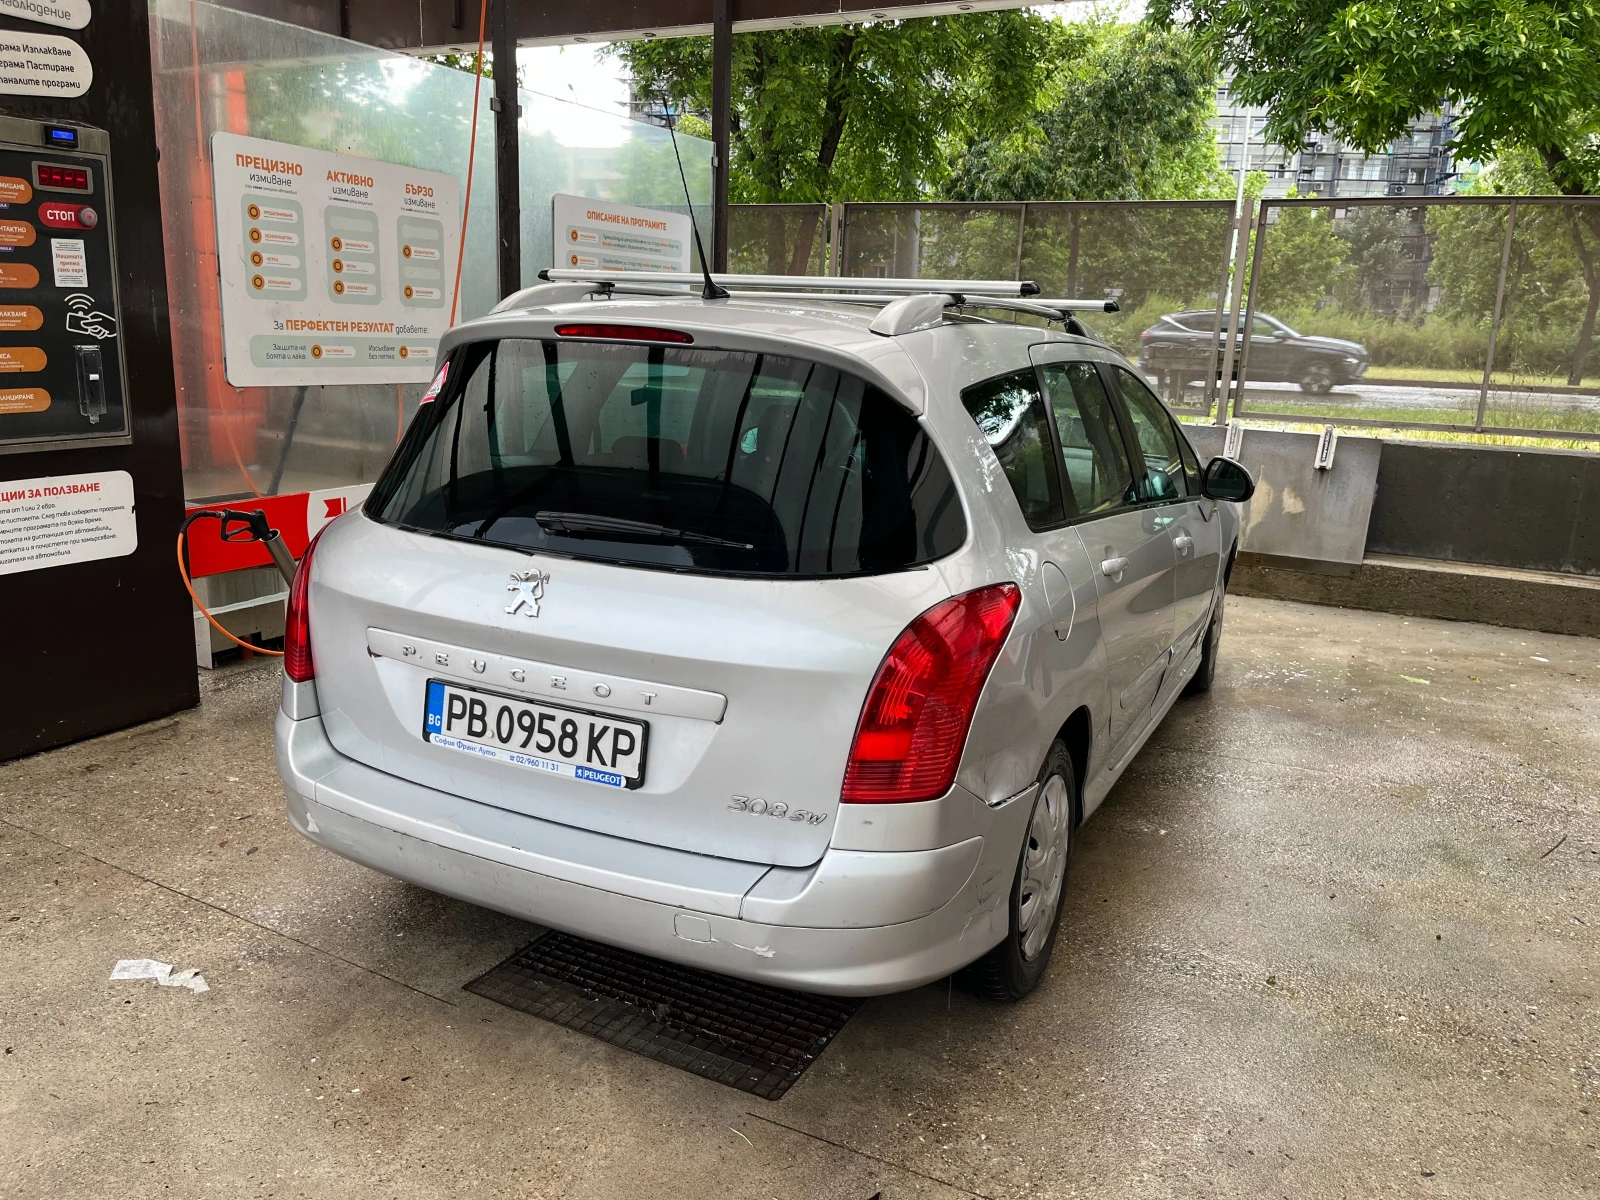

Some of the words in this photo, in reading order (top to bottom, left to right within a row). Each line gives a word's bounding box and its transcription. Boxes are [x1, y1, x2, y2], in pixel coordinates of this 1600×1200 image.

[22, 44, 72, 56] Изплакване
[26, 60, 75, 72] Пастиране
[41, 79, 81, 89] програми
[235, 153, 303, 176] ПРЕЦИЗНО
[326, 169, 374, 188] АКТИВНО
[332, 186, 369, 199] измиване
[405, 183, 434, 198] БЪРЗО
[404, 197, 436, 209] измиване
[46, 209, 75, 222] СТОП
[586, 210, 620, 224] ОПИСАНИЕ
[621, 216, 630, 225] НА
[630, 217, 667, 231] ПРОГРАМИТЕ
[273, 320, 284, 330] За
[285, 319, 349, 332] ПЕРФЕКТЕН
[350, 321, 394, 333] РЕЗУЛТАТ
[395, 324, 429, 335] добавете:
[272, 343, 298, 351] Защита
[266, 352, 286, 360] боята
[368, 352, 378, 360] без
[28, 489, 42, 499] ЗА
[43, 482, 101, 497] ПОЛЗВАНЕ
[6, 515, 40, 523] пистолета.
[23, 523, 59, 532] програмата
[32, 531, 64, 541] дистанция
[35, 541, 69, 550] почистете
[401, 644, 658, 706] PEUGEOT
[428, 713, 441, 726] BG
[445, 693, 488, 738] PB
[495, 705, 579, 758] 0958
[586, 722, 636, 768] KP
[434, 735, 455, 746] София
[456, 741, 477, 752] Франс
[478, 747, 497, 757] Ауто
[515, 756, 540, 768] 02/960
[541, 760, 549, 770] 11
[550, 762, 560, 772] 31
[584, 770, 621, 785] PEUGEOT
[727, 794, 788, 819] 308
